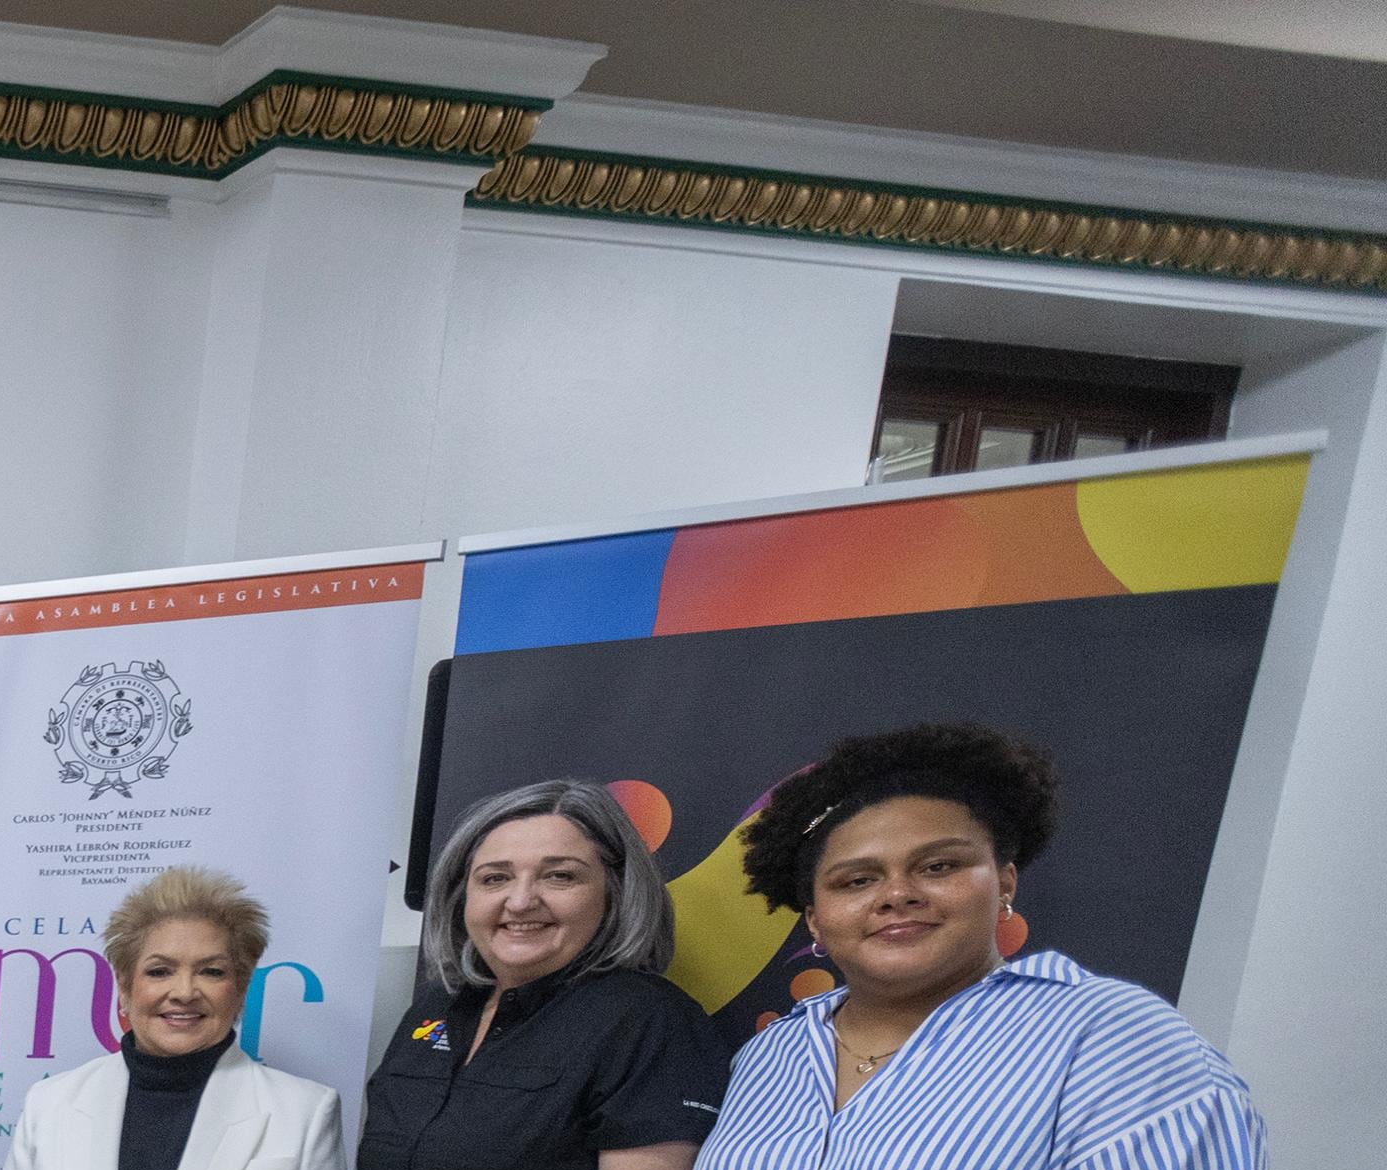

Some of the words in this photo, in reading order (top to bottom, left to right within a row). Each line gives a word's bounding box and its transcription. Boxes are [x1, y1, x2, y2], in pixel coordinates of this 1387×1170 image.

[35, 598, 176, 621] ASAMBLEA
[199, 577, 399, 605] LEGISLATIVA
[13, 814, 56, 824] CARLOS
[116, 808, 166, 820] MÉNDEZ
[169, 806, 212, 817] NÚÑEZ
[75, 822, 143, 833] PRESIDENTE
[25, 844, 73, 854] YASHIRA
[76, 840, 119, 852] LEBRÓN
[123, 839, 192, 851] RODRÍGUEZ
[63, 853, 151, 863] VICEPRESIDENTA
[38, 867, 114, 877] REPRESENTANTE
[117, 865, 165, 875] DISTRITO
[81, 876, 127, 885] BAYAMÓN
